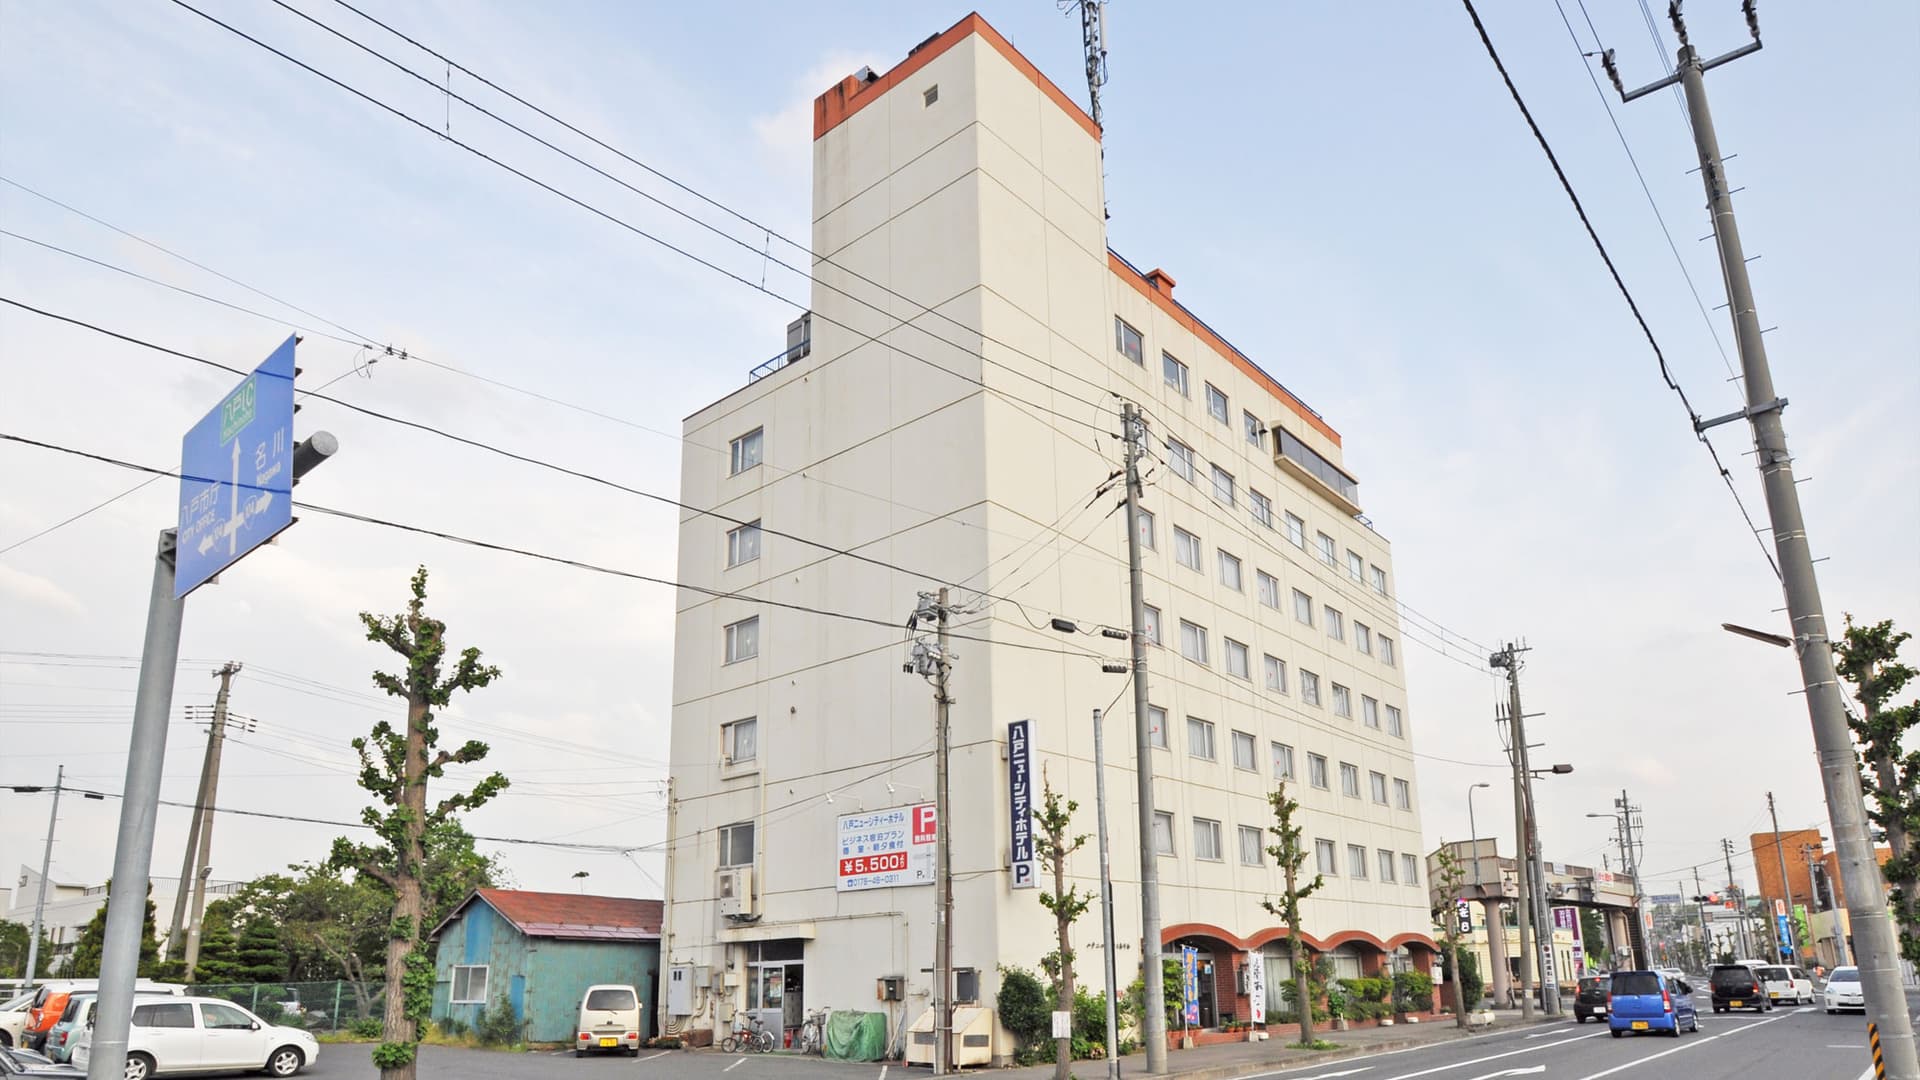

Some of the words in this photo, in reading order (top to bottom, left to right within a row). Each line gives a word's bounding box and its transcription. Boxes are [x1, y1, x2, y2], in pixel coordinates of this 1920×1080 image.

[256, 426, 285, 471] 名川
[1013, 725, 1029, 860] 八戸ニューシティホテル
[921, 806, 937, 833] P
[845, 855, 899, 873] ¥5,500
[1016, 864, 1030, 883] P
